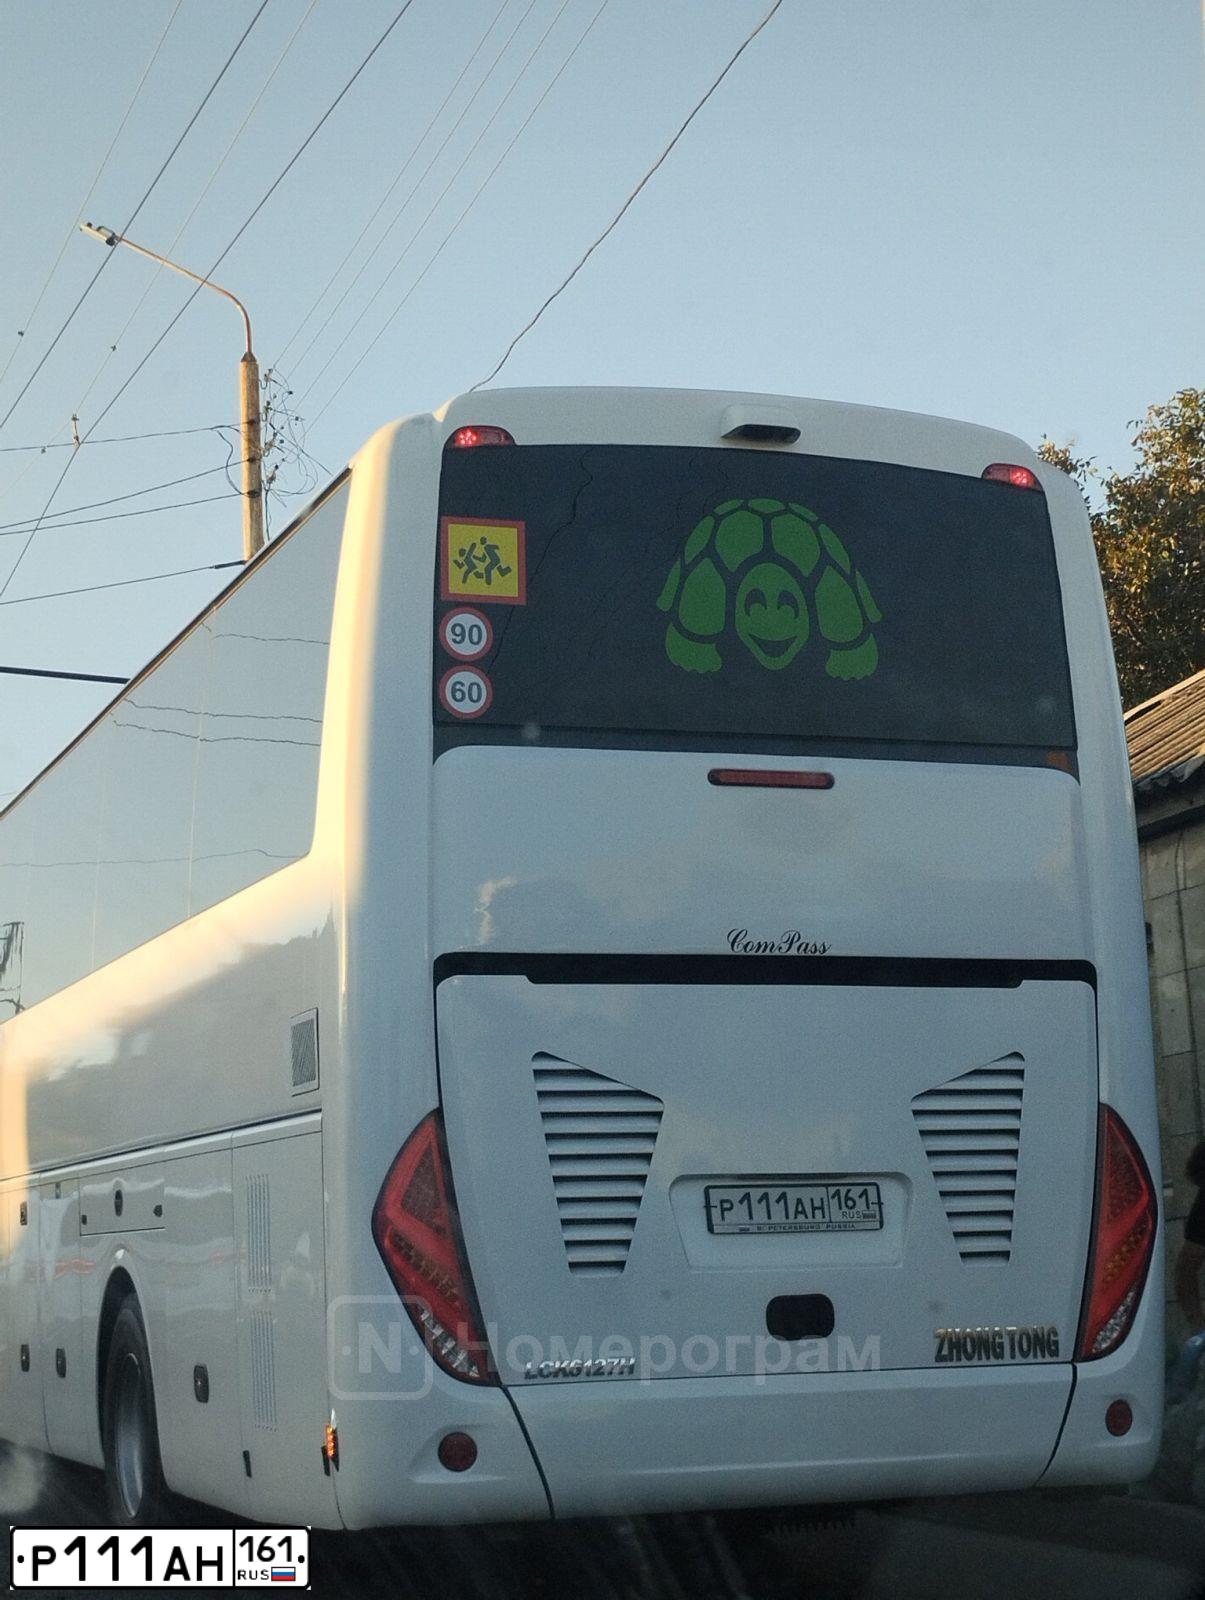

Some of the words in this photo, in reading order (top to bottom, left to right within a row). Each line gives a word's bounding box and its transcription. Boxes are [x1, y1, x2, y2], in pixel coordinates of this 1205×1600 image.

[450, 623, 483, 646] 90
[450, 681, 483, 704] 60
[726, 928, 832, 955] ComPass
[830, 1188, 871, 1210] 161
[841, 1210, 862, 1219] RUS
[523, 1357, 636, 1380] LCK6127H
